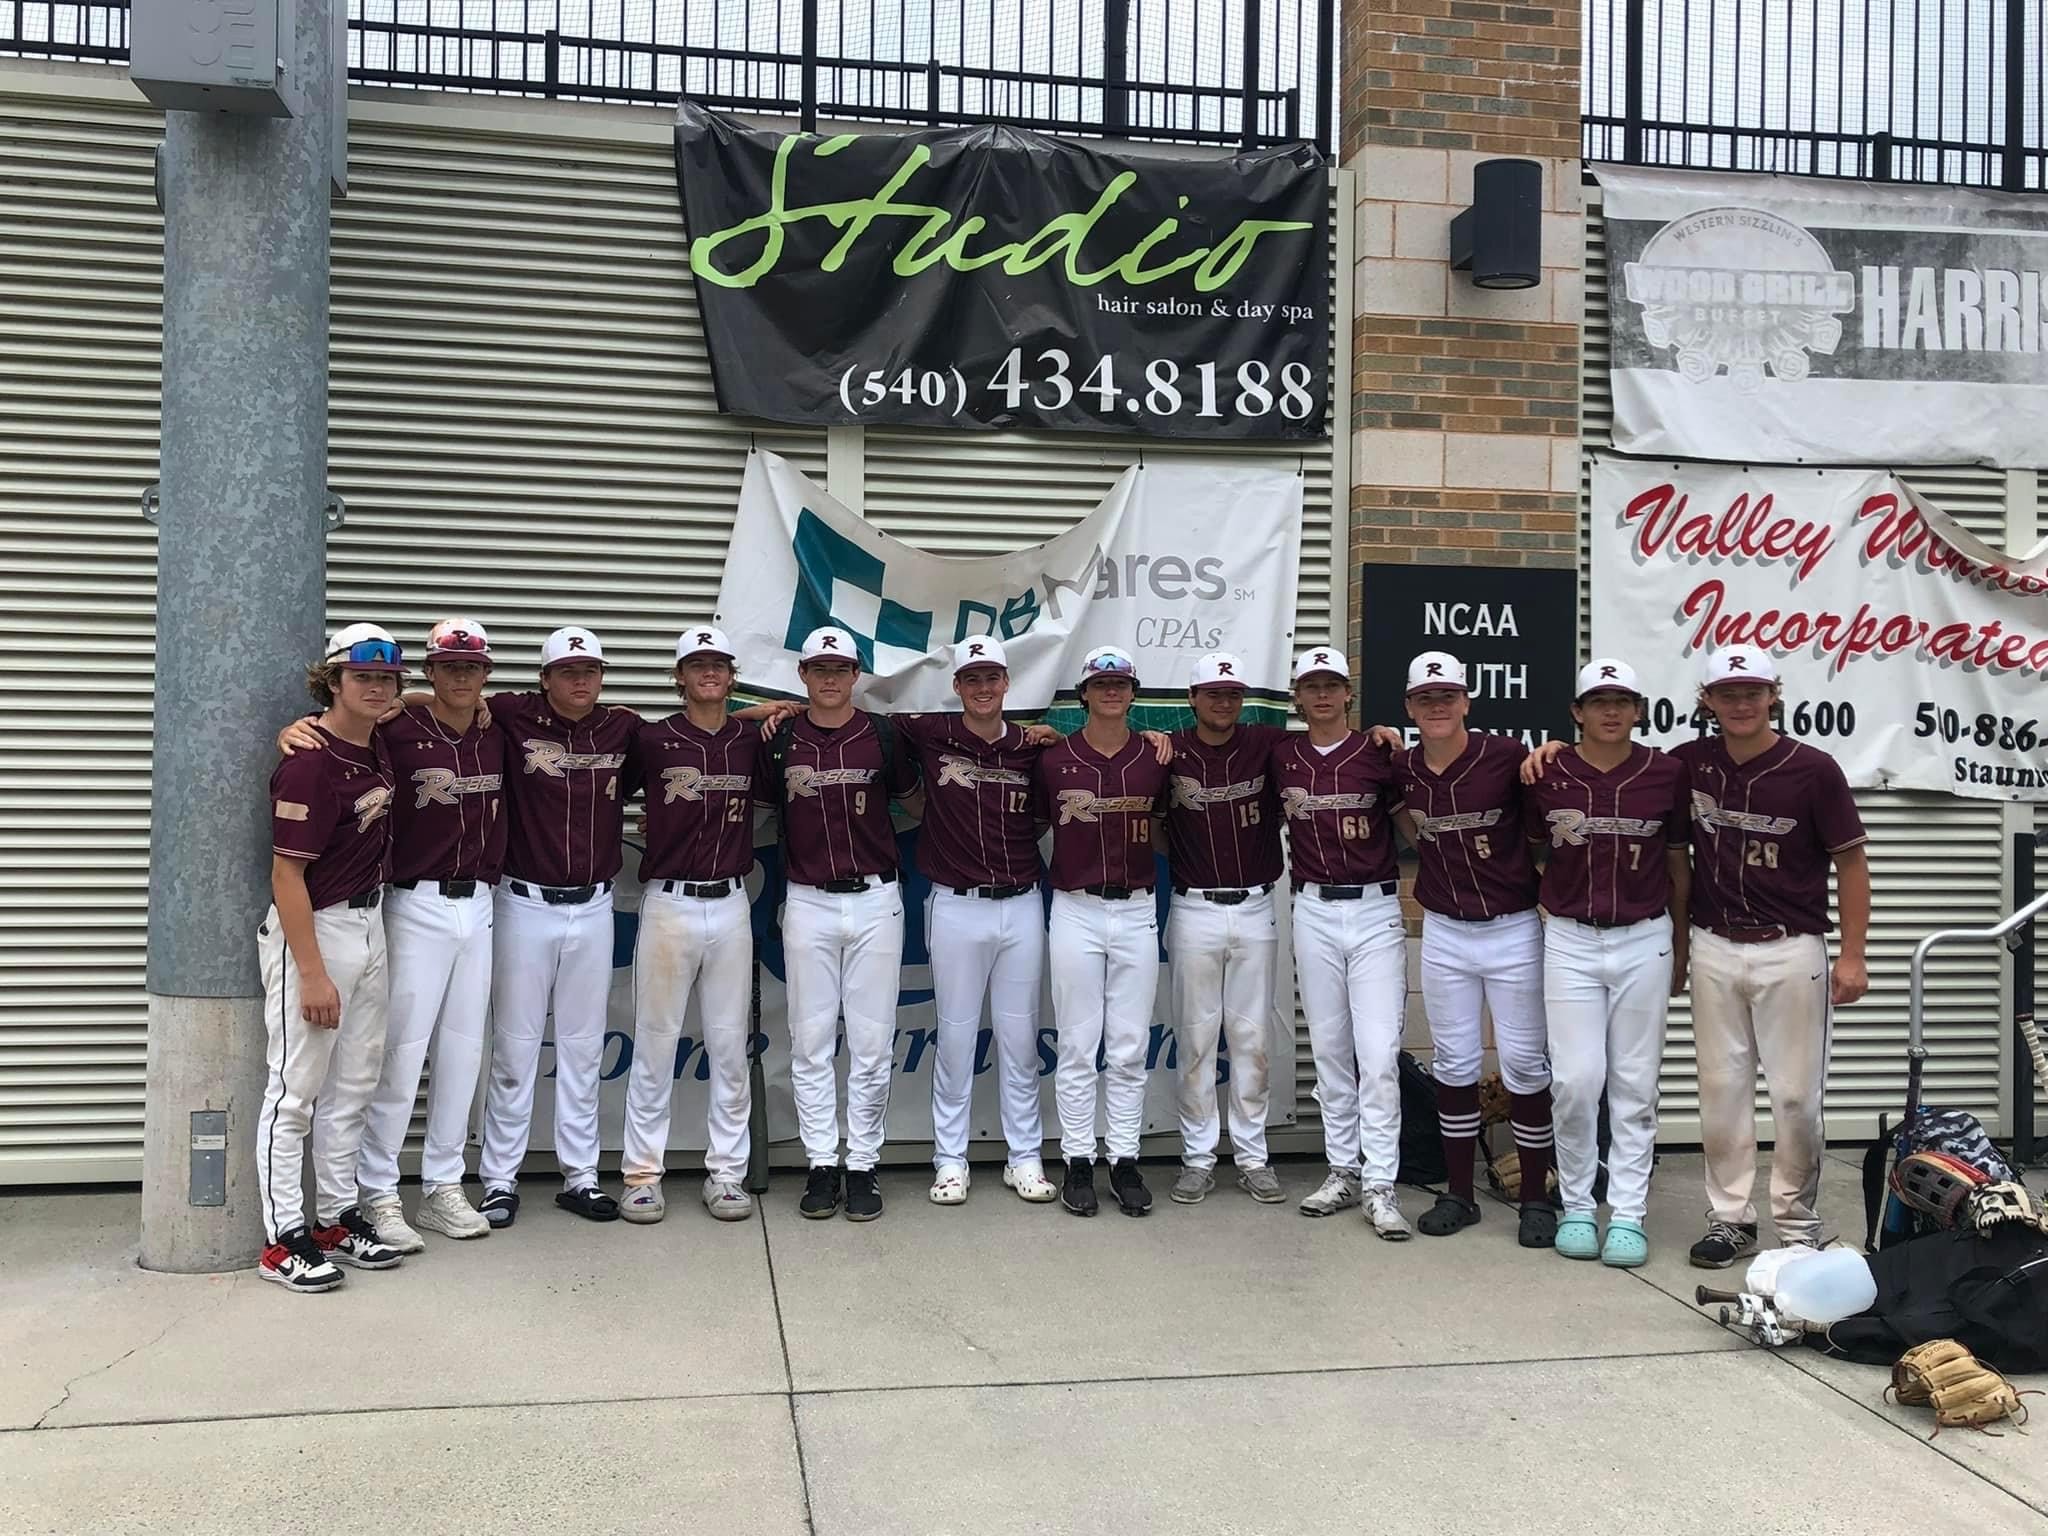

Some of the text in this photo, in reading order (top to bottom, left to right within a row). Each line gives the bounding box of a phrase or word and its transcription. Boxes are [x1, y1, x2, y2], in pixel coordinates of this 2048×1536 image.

[690, 134, 1313, 291] Studio
[1673, 214, 1735, 243] WESTERN
[1097, 294, 1314, 324] hair salon & day spa
[1695, 308, 1782, 323] BUFFET
[1862, 264, 2048, 352] HARRI
[839, 347, 1314, 420] (540) 434.8188
[1617, 483, 1835, 590] Valley
[1423, 602, 1520, 637] NCAA
[568, 637, 587, 651] R
[698, 633, 714, 646] R
[822, 636, 839, 650] R
[1136, 616, 1222, 649] CPAs
[969, 644, 986, 658] R
[1314, 653, 1330, 665] R
[1728, 656, 1748, 671] R
[1218, 663, 1234, 677] R
[1426, 663, 1445, 677] R
[1463, 663, 1529, 699] UTH
[1601, 666, 1619, 680] R
[1914, 701, 2048, 752] 50-886-
[411, 768, 504, 809] REBEL
[605, 776, 617, 801] 4
[855, 791, 867, 816] 9
[1239, 801, 1261, 828] 15
[1132, 819, 1149, 843] 19
[1343, 816, 1371, 840] 68
[1474, 834, 1492, 859] 5
[1629, 843, 1642, 871] 7
[1746, 839, 1780, 869] 28
